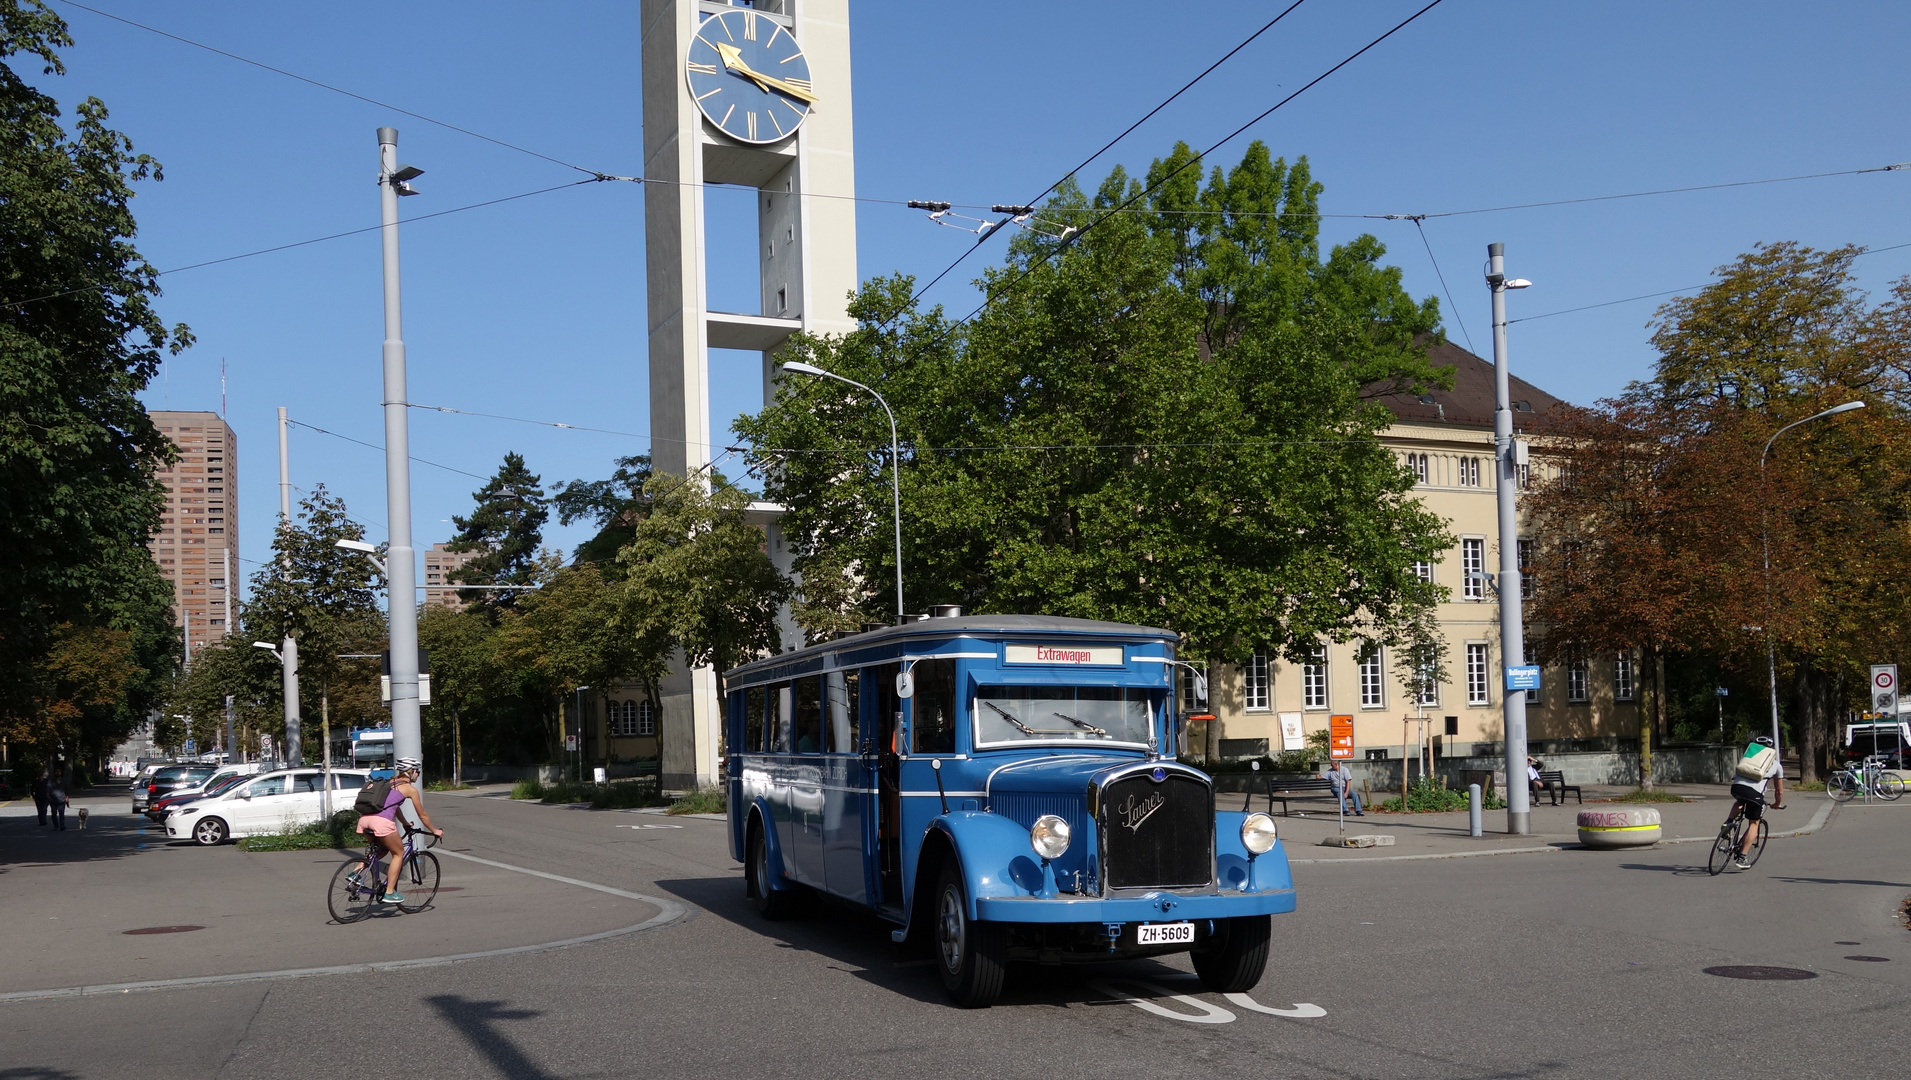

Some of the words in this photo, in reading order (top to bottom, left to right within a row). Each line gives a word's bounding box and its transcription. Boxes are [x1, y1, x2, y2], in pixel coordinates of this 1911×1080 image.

[1037, 645, 1091, 664] Extrawagen
[1508, 668, 1538, 677] Bullingerplatz
[1880, 676, 1888, 684] 30
